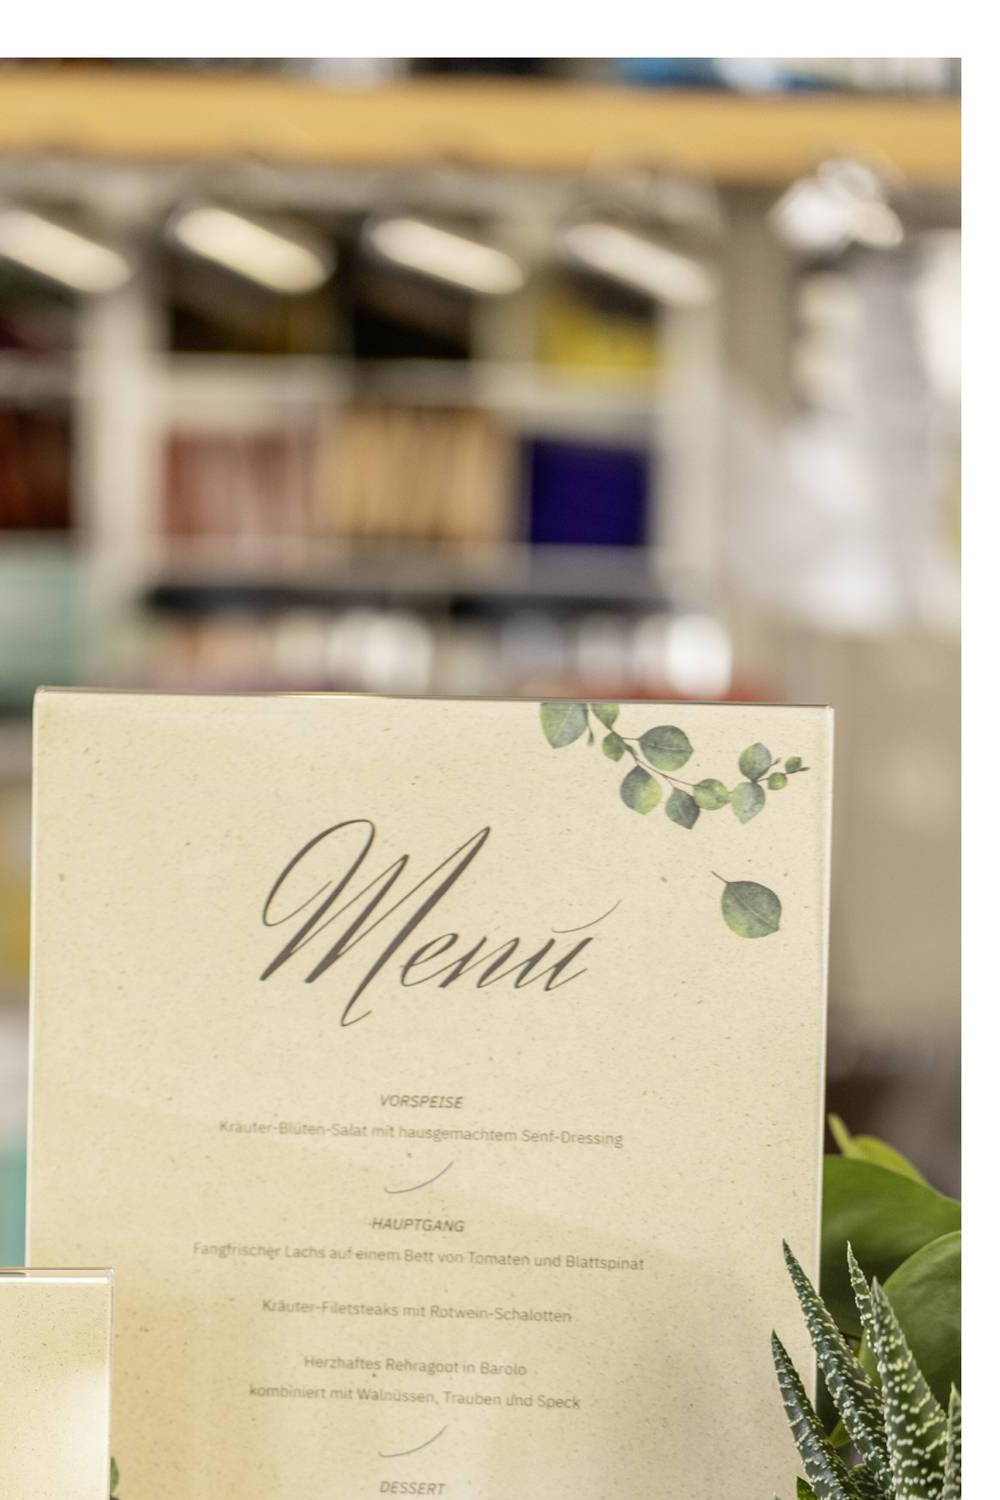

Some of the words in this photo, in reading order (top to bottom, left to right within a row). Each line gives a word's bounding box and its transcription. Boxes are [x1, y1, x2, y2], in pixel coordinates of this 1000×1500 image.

[379, 1094, 464, 1109] VORSPEISE
[217, 1119, 368, 1137] Kräuter-Blüten-Salat
[370, 1124, 395, 1137] mit
[397, 1127, 518, 1144] hausgemachtem
[520, 1129, 624, 1148] Senf-Dressing
[370, 1217, 466, 1232] HAUPTGANG
[192, 1241, 281, 1260] Fangfrischer
[283, 1245, 326, 1259] Lachs
[328, 1246, 353, 1260] auf
[354, 1249, 401, 1261] einem
[402, 1248, 434, 1263] Bett
[436, 1252, 464, 1263] von
[468, 1250, 531, 1266] Tomaten
[532, 1254, 563, 1267] und
[564, 1254, 645, 1270] Blattspinat
[260, 1299, 399, 1316] Kräuter-Filetsteaks
[401, 1305, 426, 1317] mit
[428, 1304, 573, 1322] Rotwein-Schalotten
[302, 1355, 382, 1371] Herzhaftes
[461, 1360, 476, 1373] in
[478, 1361, 527, 1376] Barolo
[247, 1384, 326, 1399] kombiniert
[328, 1387, 353, 1399] mit
[355, 1388, 439, 1403] Walnüssen,
[443, 1390, 502, 1405] Trauben
[504, 1393, 534, 1407] und
[536, 1394, 581, 1410] Speck
[378, 1480, 446, 1495] DESSERT
